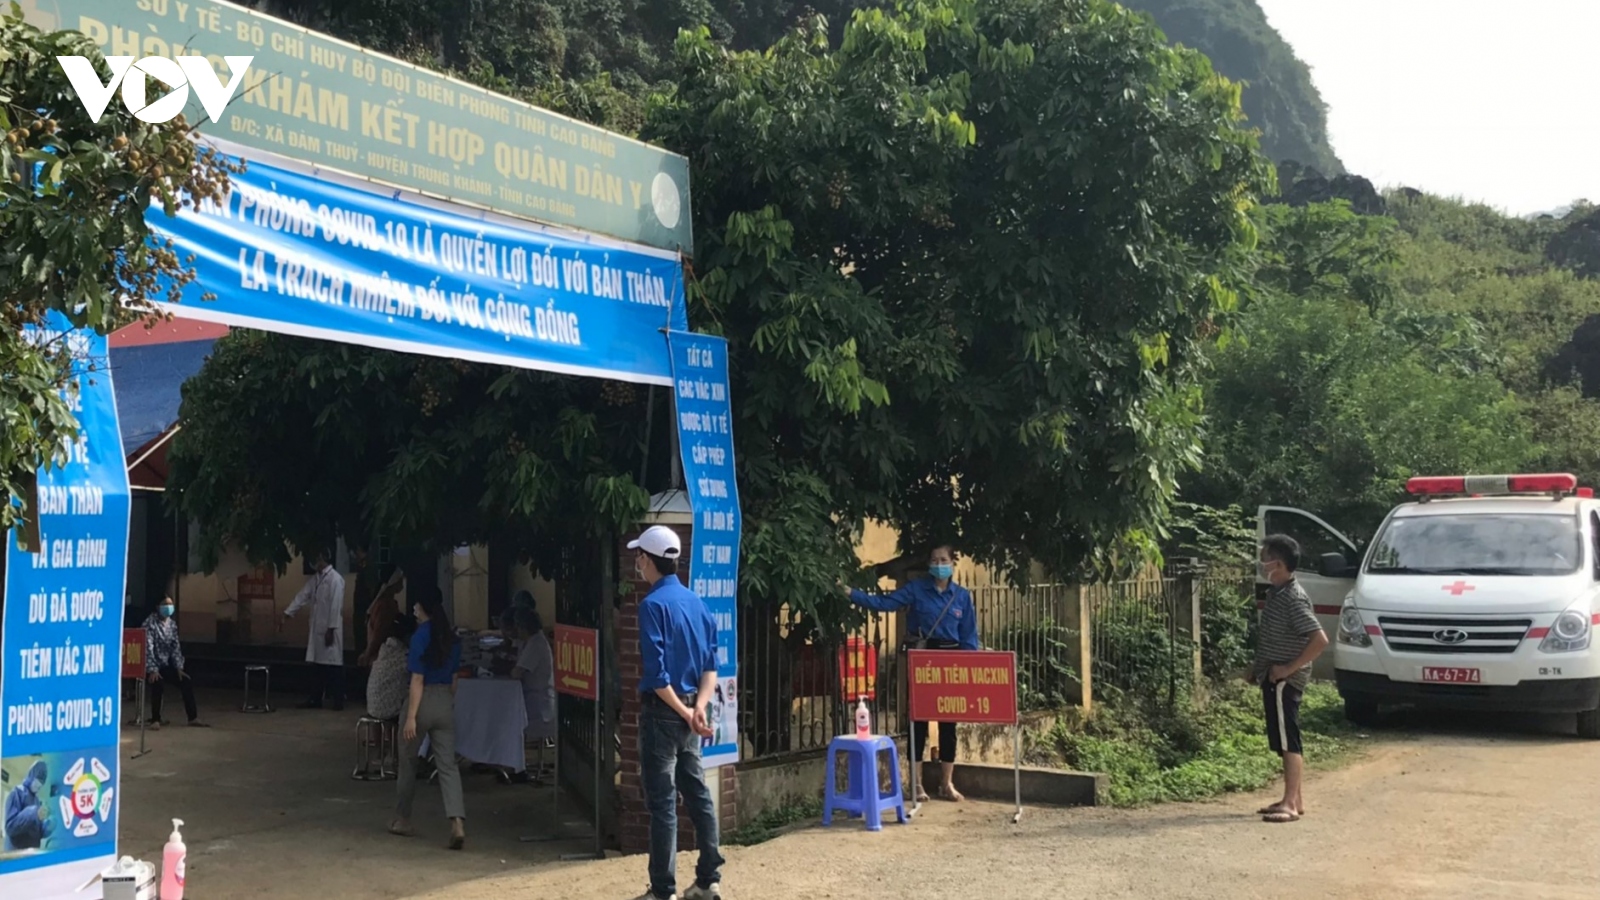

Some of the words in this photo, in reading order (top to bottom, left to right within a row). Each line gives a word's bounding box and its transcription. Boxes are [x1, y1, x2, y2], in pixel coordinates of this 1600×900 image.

[175, 0, 189, 23] Y
[236, 20, 266, 52] BỘ
[310, 44, 346, 73] HUY
[352, 58, 376, 87] BỘ
[381, 66, 411, 96] ĐỘI
[416, 78, 455, 107] BIÊN
[459, 92, 510, 125] PHÒNG
[550, 123, 577, 146] CAO
[243, 66, 350, 131] KHÁM
[361, 98, 420, 149] KẾT
[428, 119, 485, 171] HỢP
[493, 144, 568, 191] QUÂN
[574, 162, 623, 206] DÂN
[629, 180, 643, 210] Y
[230, 115, 261, 138] Đ/C:
[265, 123, 285, 145] XÃ
[367, 151, 409, 177] HUYỆN
[525, 193, 546, 211] CAO
[238, 181, 316, 238] PHÒNG
[412, 219, 438, 266] LÀ
[501, 246, 528, 290] LỢI
[531, 243, 560, 289] ĐỐI
[562, 251, 589, 294] VỚI
[591, 252, 624, 300] BẢN
[485, 293, 533, 342] CỘNG
[39, 473, 68, 515] BẢN
[69, 481, 103, 515] THÂN
[52, 539, 73, 569] GIA
[76, 533, 107, 568] ĐÌNH
[28, 587, 46, 624] DÙ
[50, 587, 68, 623] ĐÃ
[71, 589, 104, 628] ĐƯỢC
[20, 641, 51, 679] TIÊM
[55, 636, 80, 677] VẮC
[83, 644, 105, 674] XIN
[573, 639, 593, 676] VÀO
[915, 660, 941, 684] ĐIỂM
[943, 663, 969, 684] TIÊM
[971, 667, 1009, 685] VACXIN
[8, 696, 53, 736] PHÒNG
[57, 696, 113, 731] COVID-19
[937, 696, 967, 714] COVID
[976, 697, 990, 714] 19
[79, 794, 94, 808] 5K
